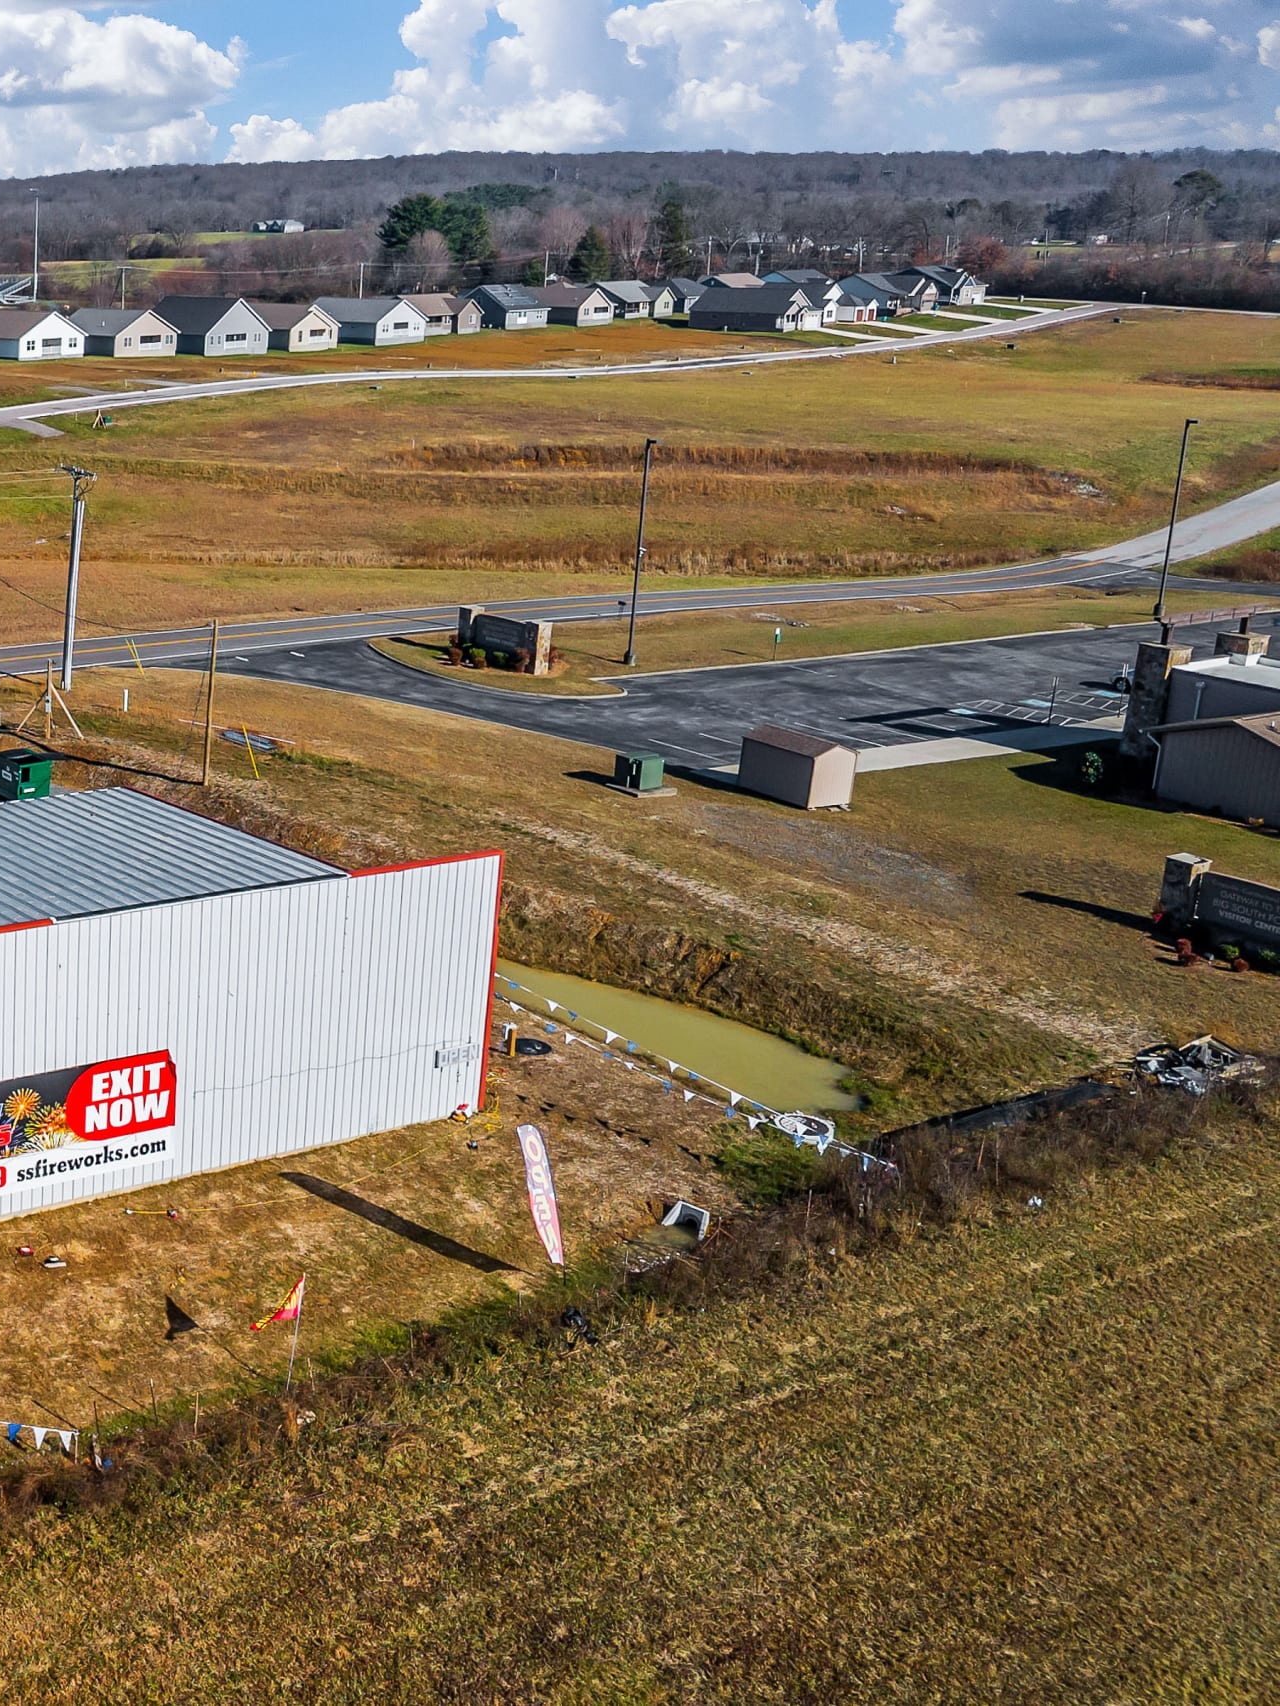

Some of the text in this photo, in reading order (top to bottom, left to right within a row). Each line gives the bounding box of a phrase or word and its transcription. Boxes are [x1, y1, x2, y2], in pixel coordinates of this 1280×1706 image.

[1219, 909, 1252, 925] VISITOR
[439, 1044, 479, 1065] OPEN
[92, 1062, 166, 1102] EXIT
[85, 1090, 170, 1133] NOW
[16, 1139, 166, 1182] ssfireworks.com
